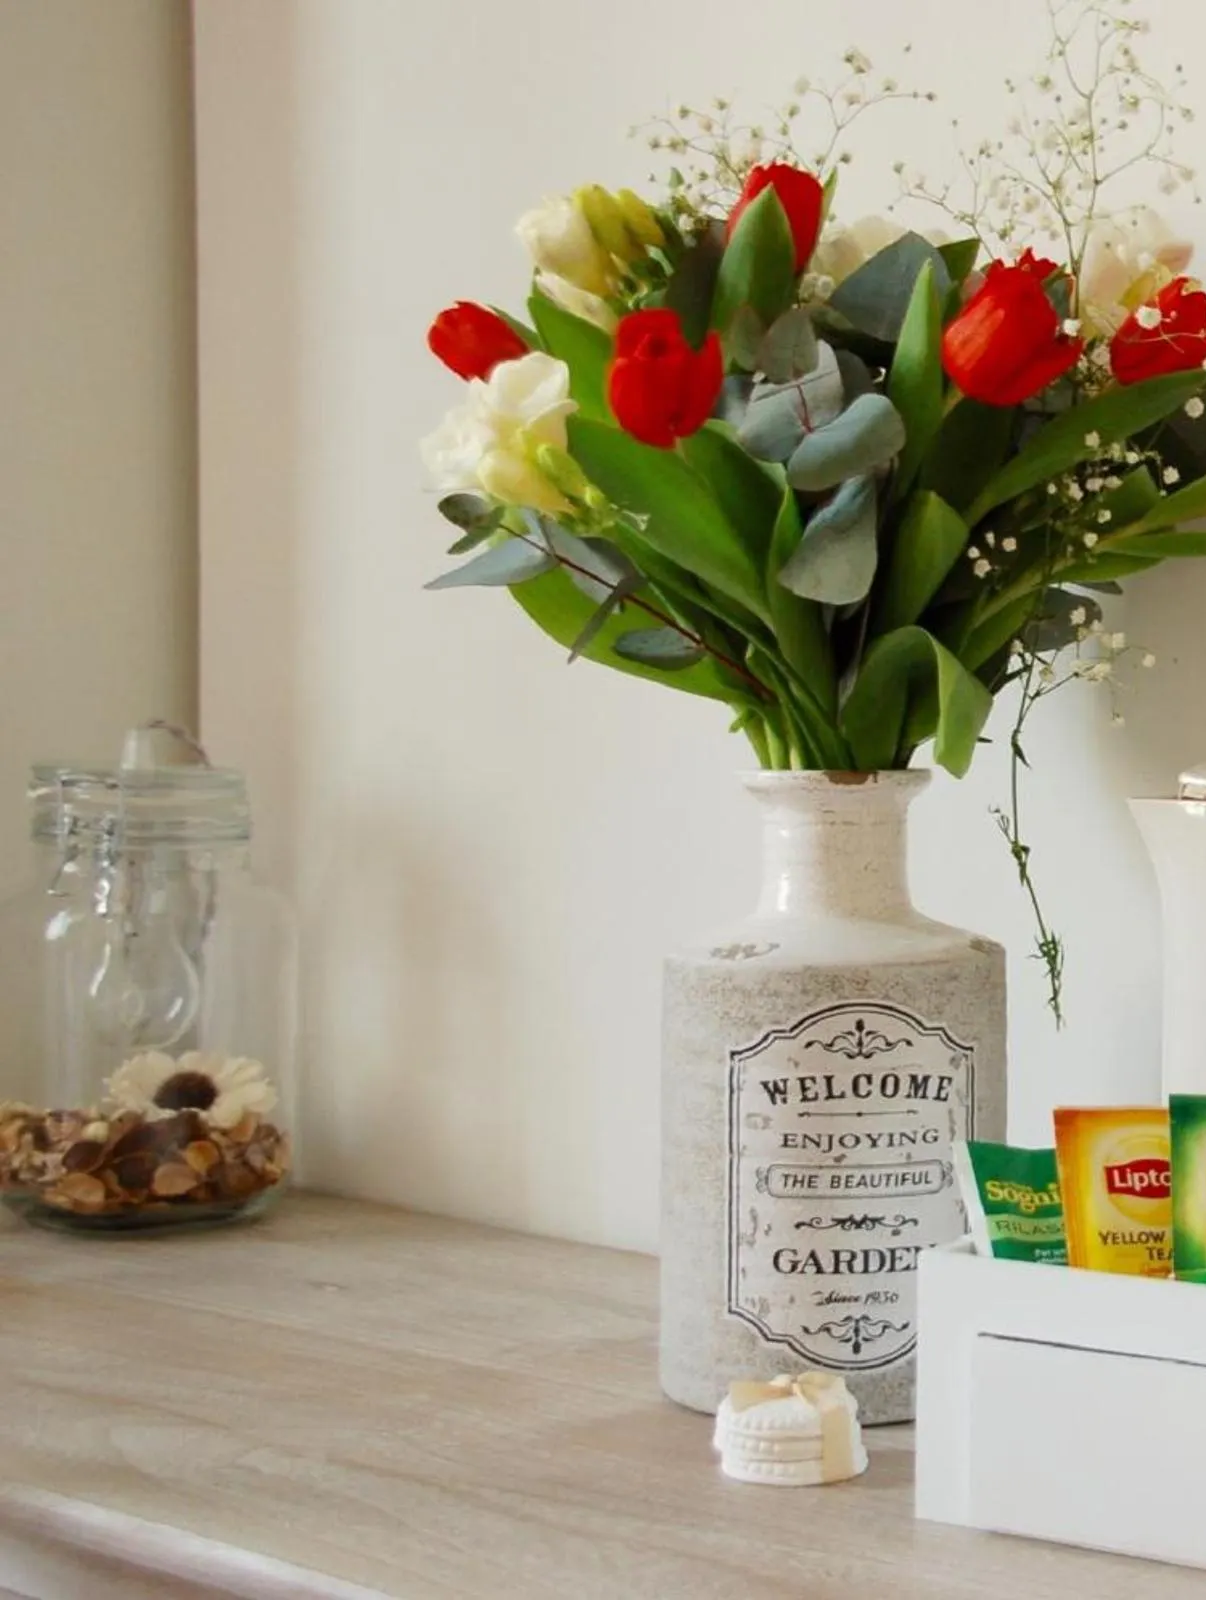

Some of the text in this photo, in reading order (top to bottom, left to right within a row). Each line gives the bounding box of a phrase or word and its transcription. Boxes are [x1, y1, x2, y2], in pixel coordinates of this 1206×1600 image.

[760, 1073, 953, 1106] WELCOME
[780, 1128, 940, 1153] ENJOYING
[781, 1171, 933, 1190] THE BEAUTIFUL
[995, 1220, 1065, 1236] RILAS
[1099, 1230, 1166, 1246] YELLOW
[811, 1290, 861, 1306] Since
